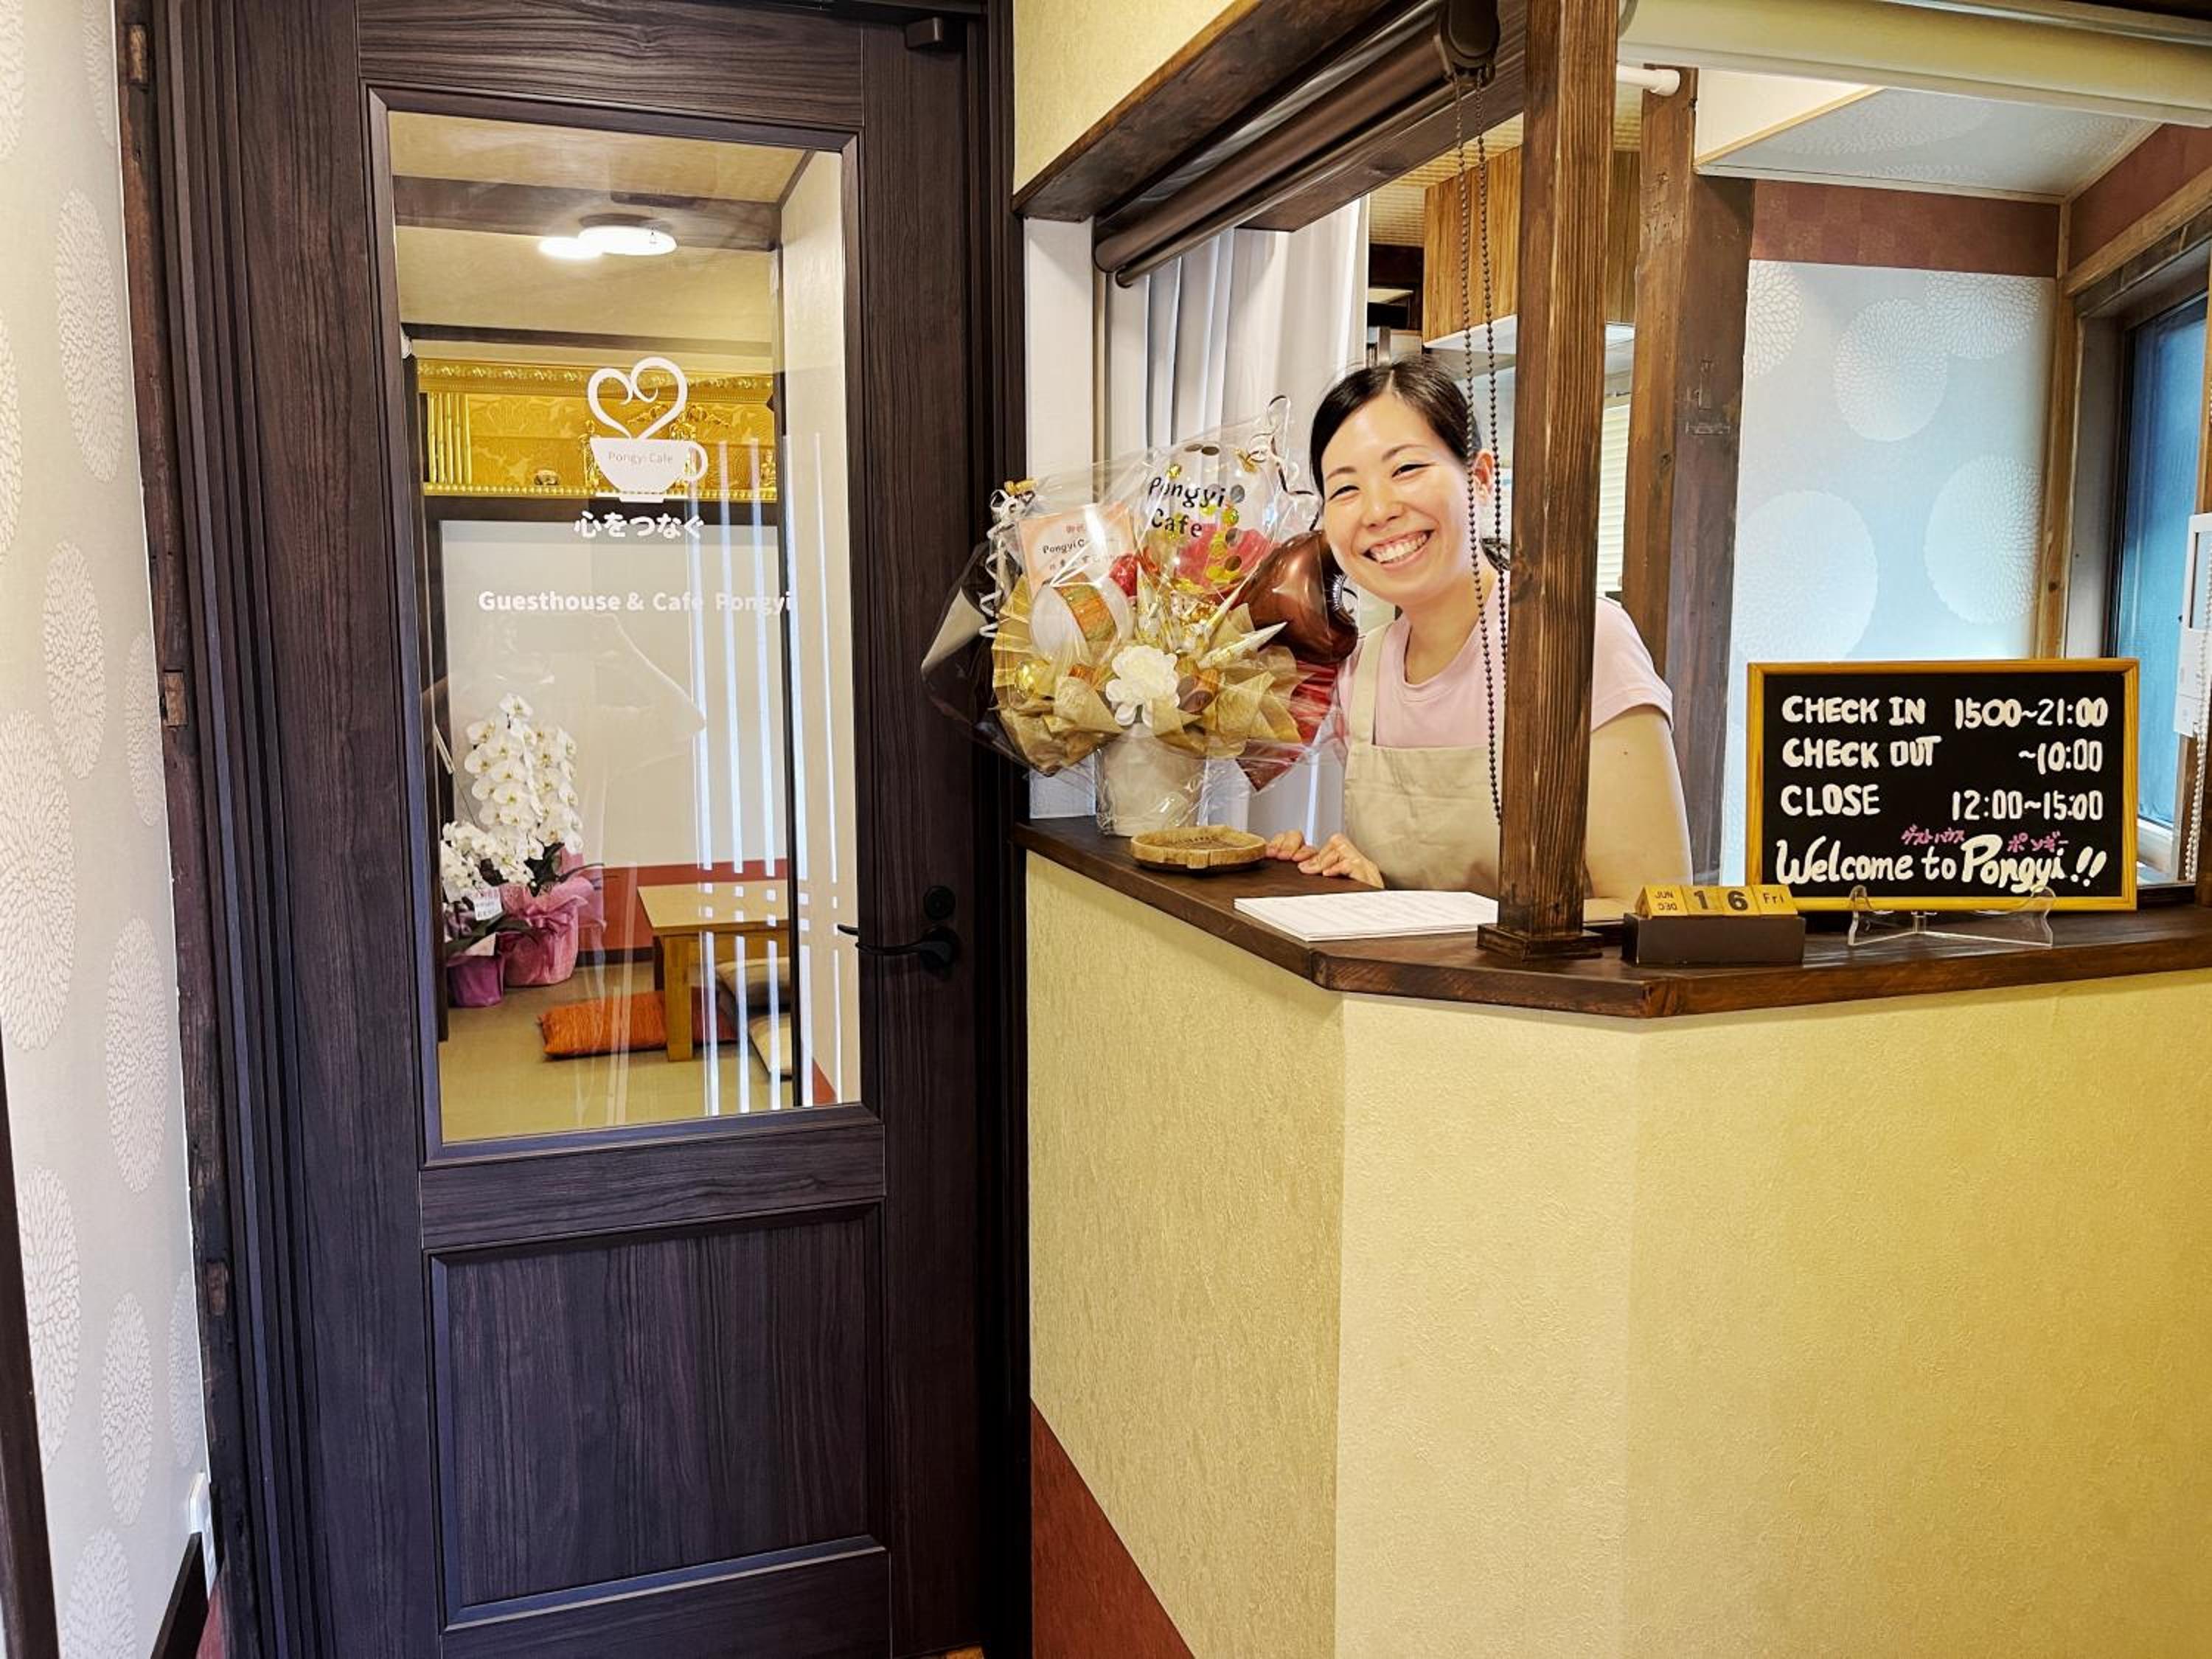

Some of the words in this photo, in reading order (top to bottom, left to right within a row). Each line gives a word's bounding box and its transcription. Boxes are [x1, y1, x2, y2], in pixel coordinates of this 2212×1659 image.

[574, 509, 705, 539] 心をつなぐ
[1151, 508, 1203, 538] Cafe
[478, 591, 622, 611] Guesthouse
[626, 591, 644, 611] &
[715, 591, 791, 616] Pongyi
[1781, 695, 1880, 723] CHECK
[1888, 696, 1926, 726] IN
[1782, 737, 1880, 769] CHECK
[1890, 735, 1942, 767] OUT
[1781, 783, 1881, 816] CLOSE
[1901, 824, 1966, 846] ゲストハウス
[1775, 835, 1914, 885] Welcome
[1921, 846, 1957, 880] to
[1654, 890, 1674, 899] JUN
[1763, 893, 1784, 905] Fri
